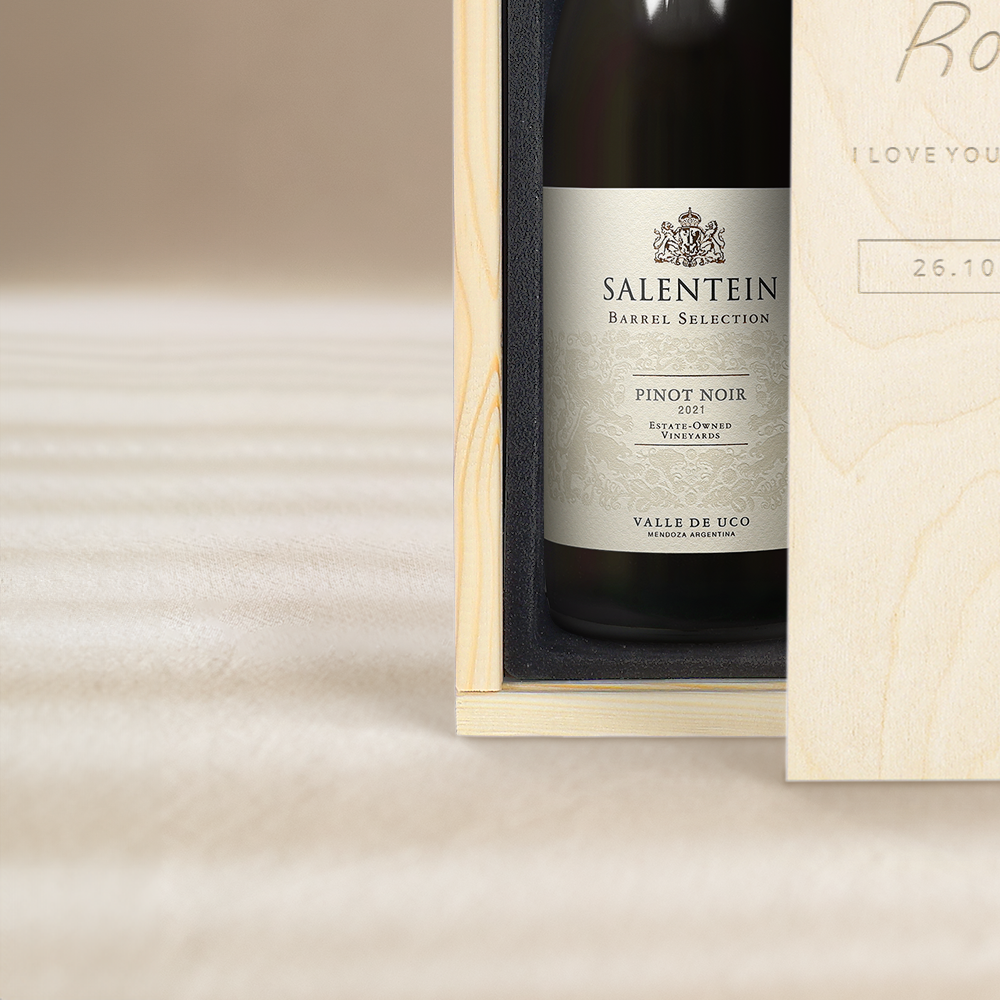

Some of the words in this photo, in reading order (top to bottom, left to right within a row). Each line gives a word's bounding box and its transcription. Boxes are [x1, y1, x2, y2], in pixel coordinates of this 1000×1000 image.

[853, 147, 858, 163] I
[869, 147, 936, 163] LOVE
[946, 147, 1000, 163] YOU
[603, 276, 778, 302] SALENTEIN
[635, 388, 693, 402] PINOT
[700, 388, 747, 402] NOIR
[678, 405, 705, 415] 2021
[633, 517, 683, 528] VALLE
[690, 517, 711, 528] DE
[717, 516, 750, 528] UCO
[647, 531, 687, 539] MENDOZA
